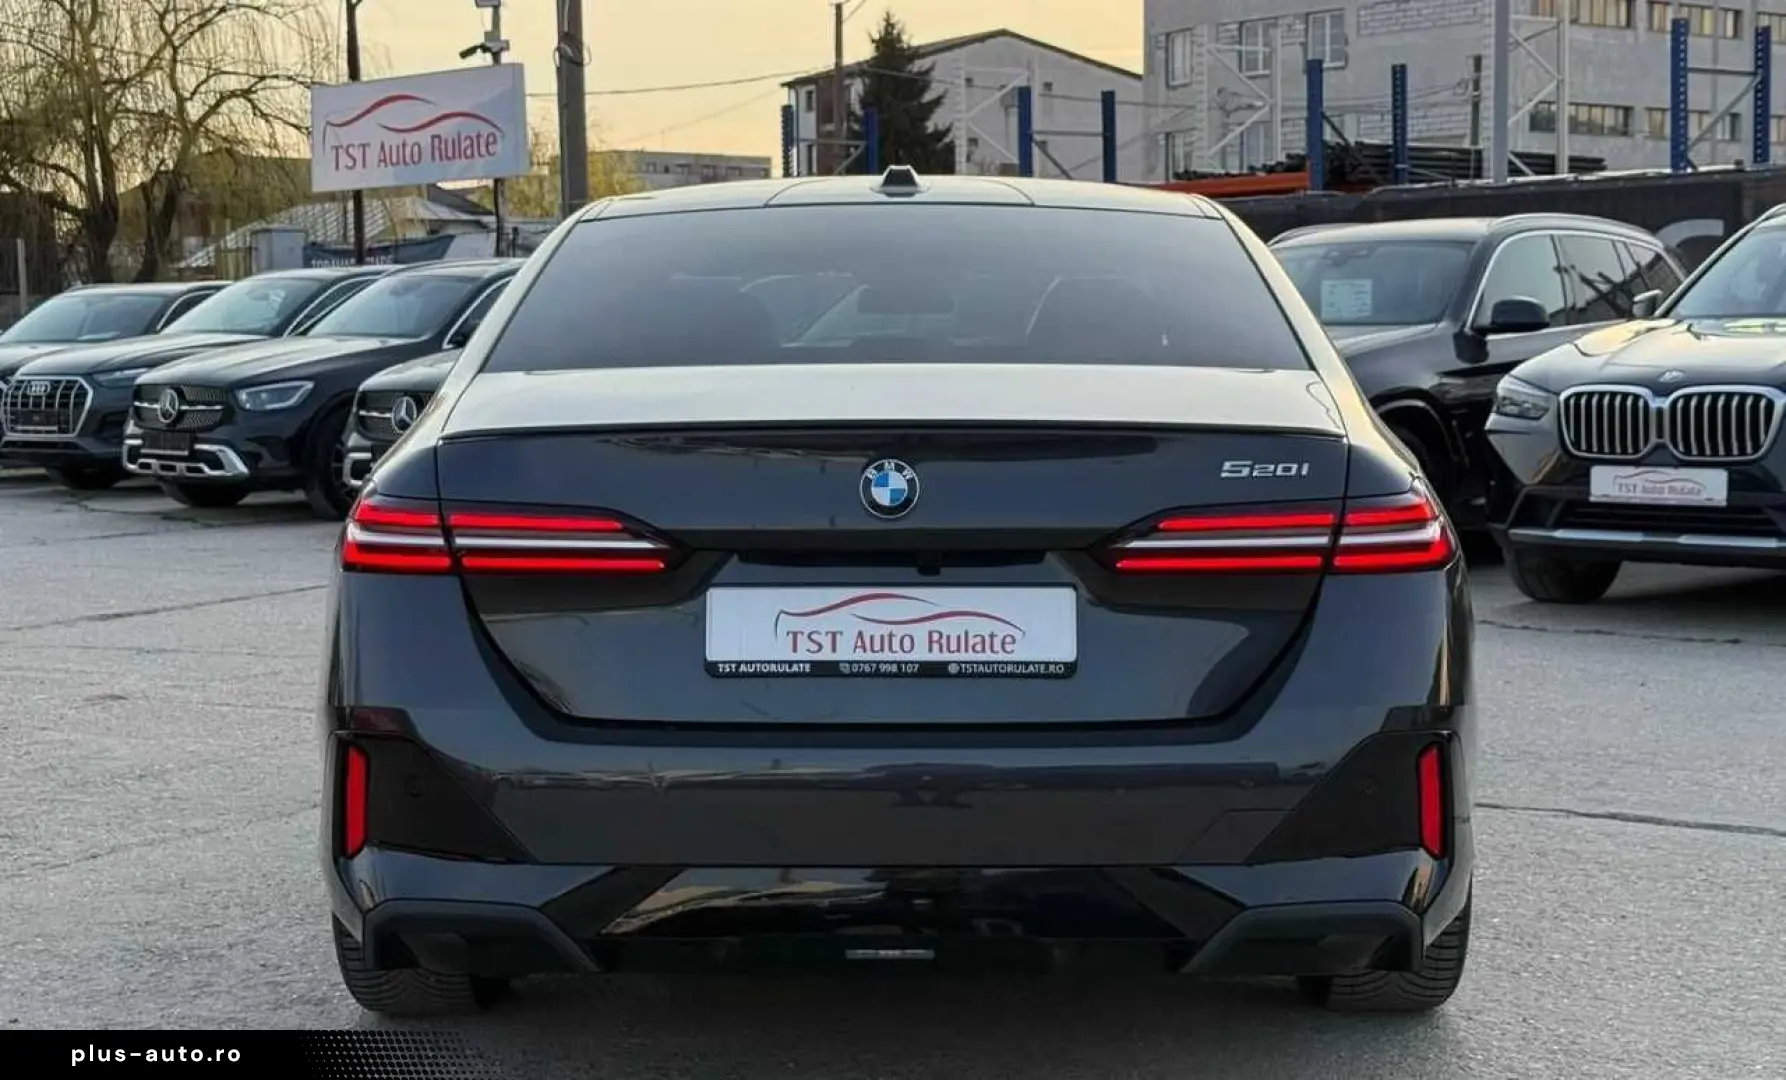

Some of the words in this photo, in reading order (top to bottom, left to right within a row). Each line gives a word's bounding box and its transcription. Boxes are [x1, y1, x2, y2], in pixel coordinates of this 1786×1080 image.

[332, 144, 371, 171] TST
[377, 139, 422, 169] Auto
[430, 131, 498, 163] Rulate
[786, 630, 843, 654] TST
[853, 629, 915, 654] Auto
[927, 629, 1017, 654] Rulate
[718, 663, 736, 673] TST
[738, 663, 811, 673] AUTORULATE
[852, 663, 876, 673] 0767
[901, 663, 920, 673] 107
